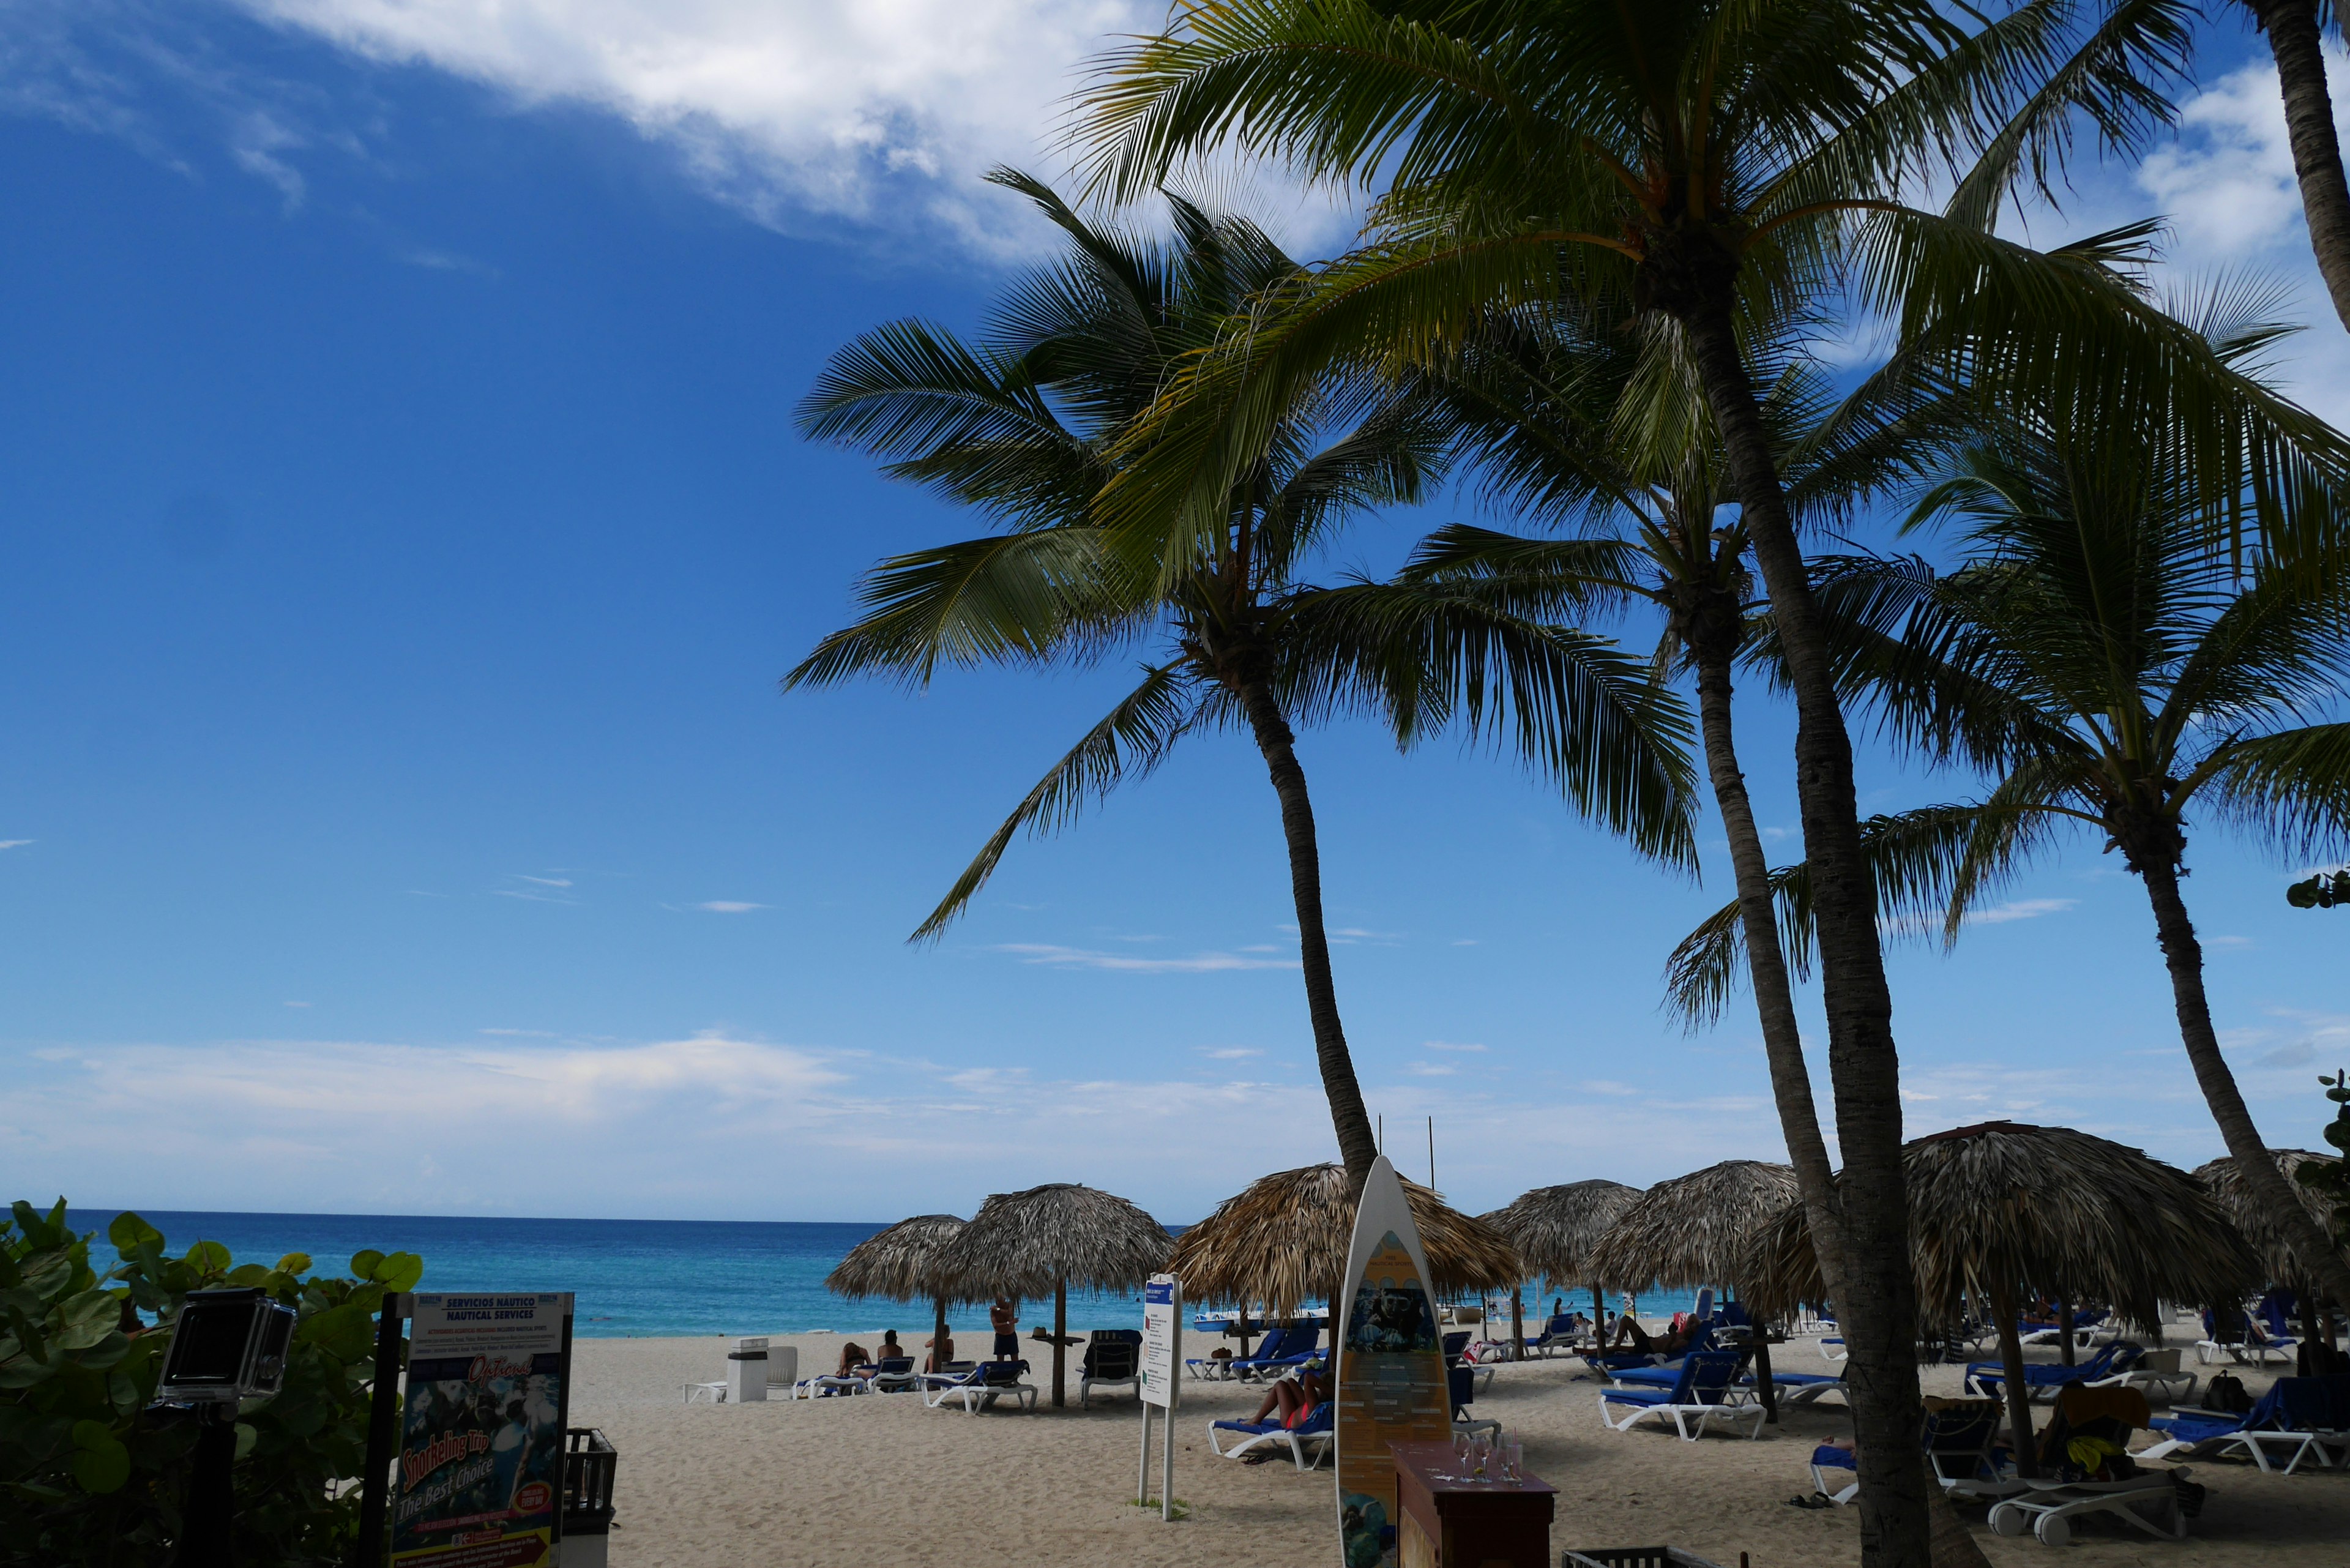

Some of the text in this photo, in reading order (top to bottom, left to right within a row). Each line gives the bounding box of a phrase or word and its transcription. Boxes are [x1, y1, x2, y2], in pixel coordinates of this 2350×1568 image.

[447, 1297, 493, 1308] SERVICIOS
[447, 1310, 534, 1321] NAUTICAL SERVICES
[468, 1353, 534, 1387] Optional
[403, 1429, 490, 1493] Snorkeling Trip
[398, 1457, 494, 1520] The Best Choice
[521, 1495, 544, 1507] EVERY DAY
